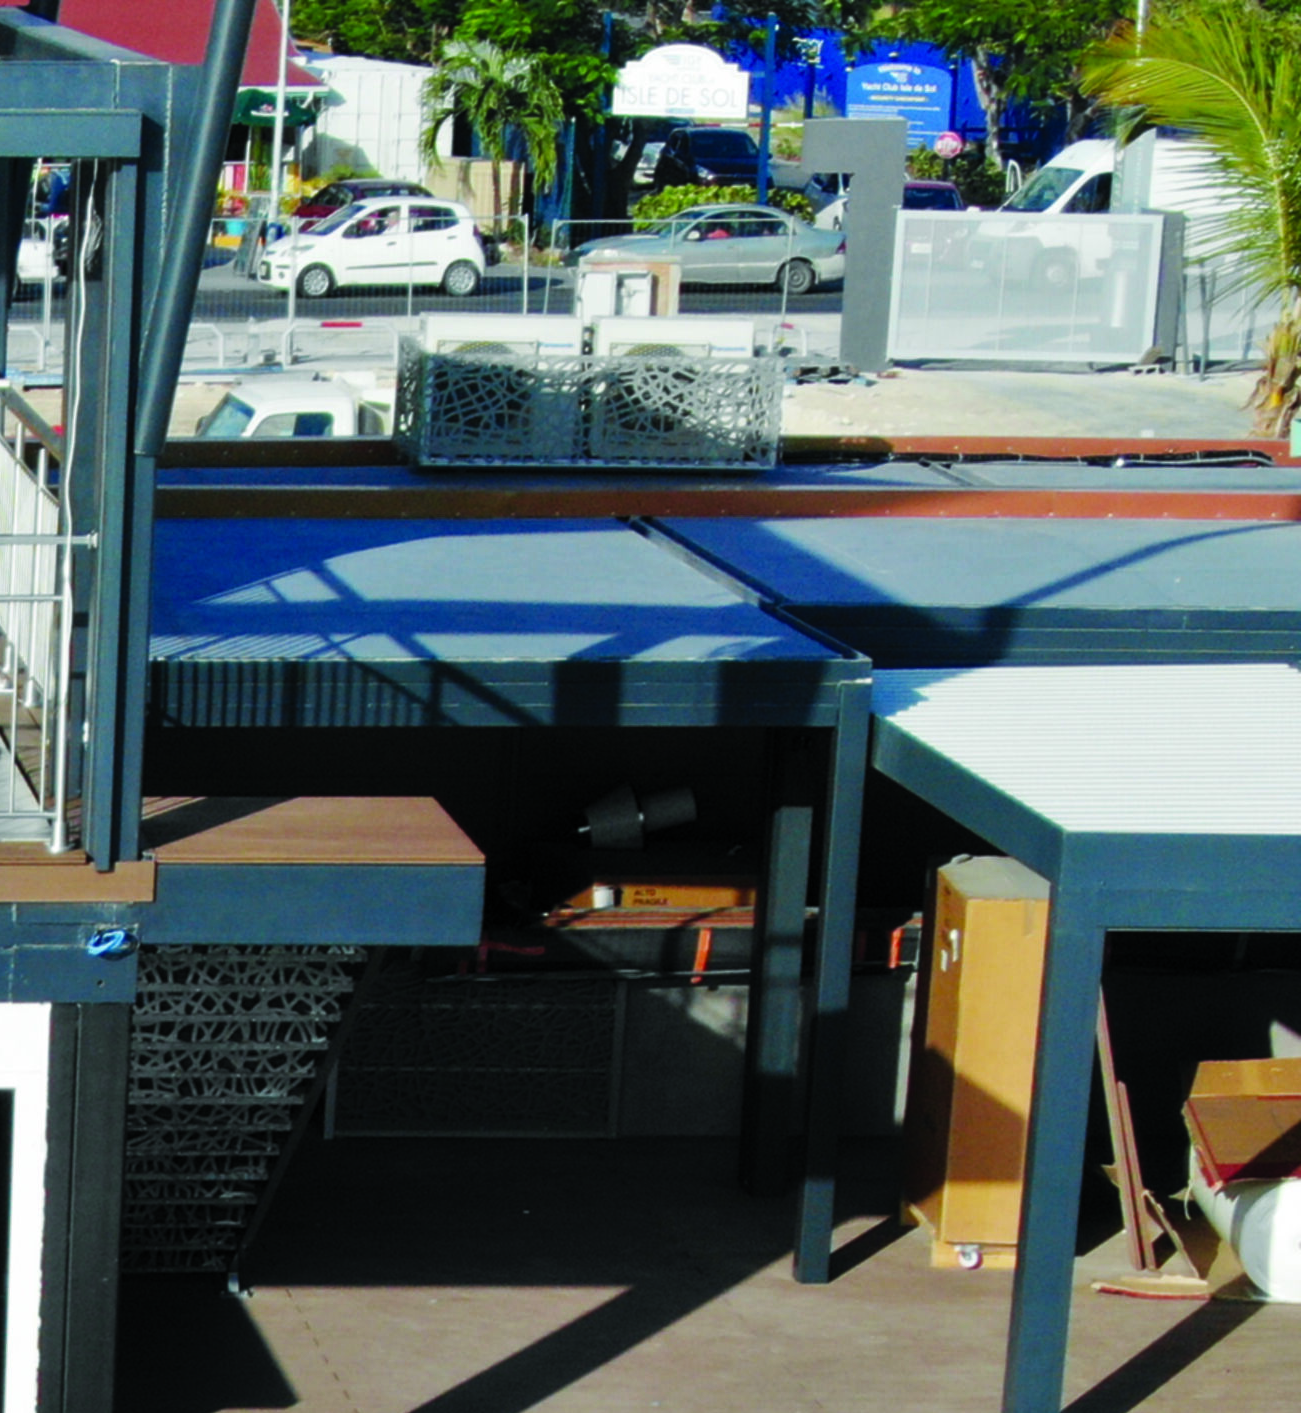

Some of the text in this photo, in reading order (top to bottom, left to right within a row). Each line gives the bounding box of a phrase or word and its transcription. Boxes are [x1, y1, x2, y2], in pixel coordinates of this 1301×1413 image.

[620, 86, 738, 108] ISLE DE SOL
